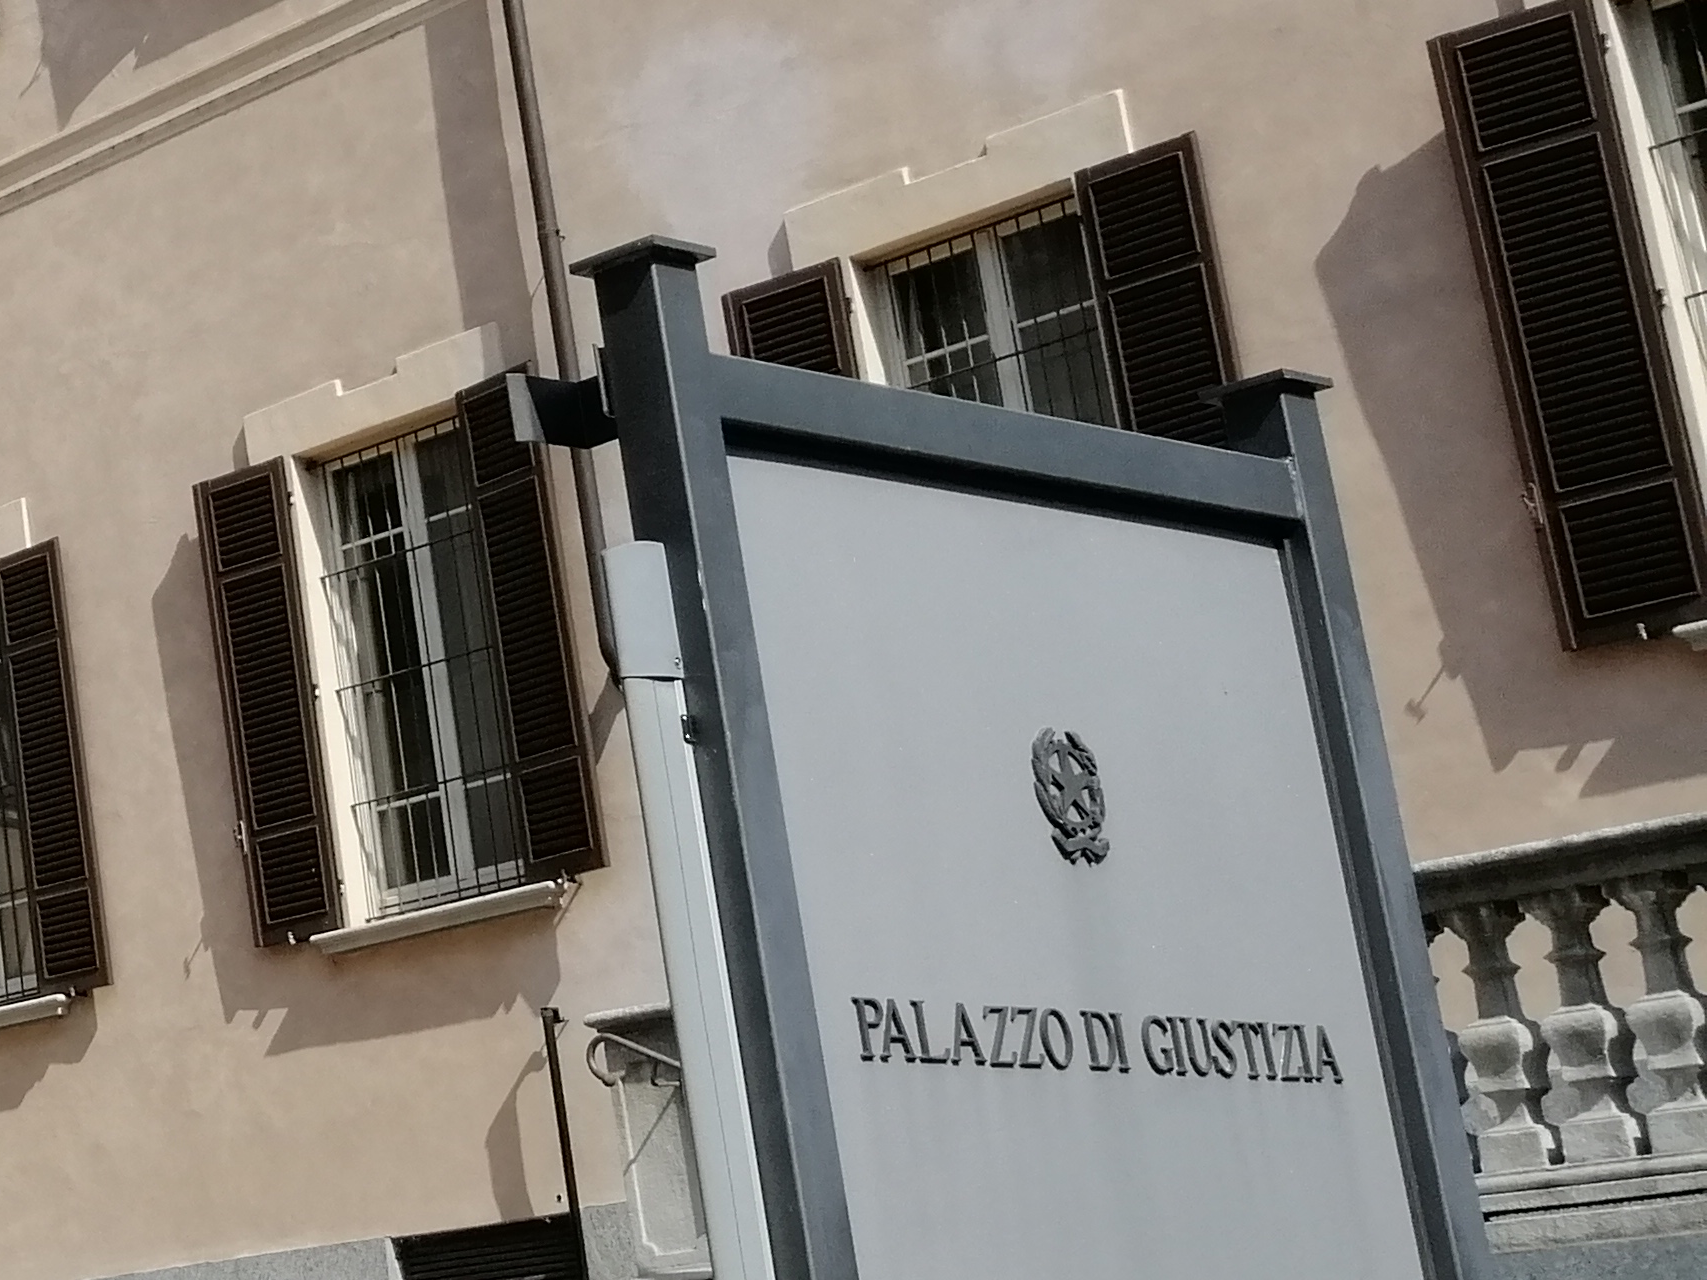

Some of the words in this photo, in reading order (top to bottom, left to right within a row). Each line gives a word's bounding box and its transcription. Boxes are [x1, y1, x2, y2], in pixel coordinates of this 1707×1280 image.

[850, 996, 1074, 1071] PALAZZO
[1079, 1010, 1131, 1074] DI
[1141, 1014, 1344, 1085] GIUSTIZIA
